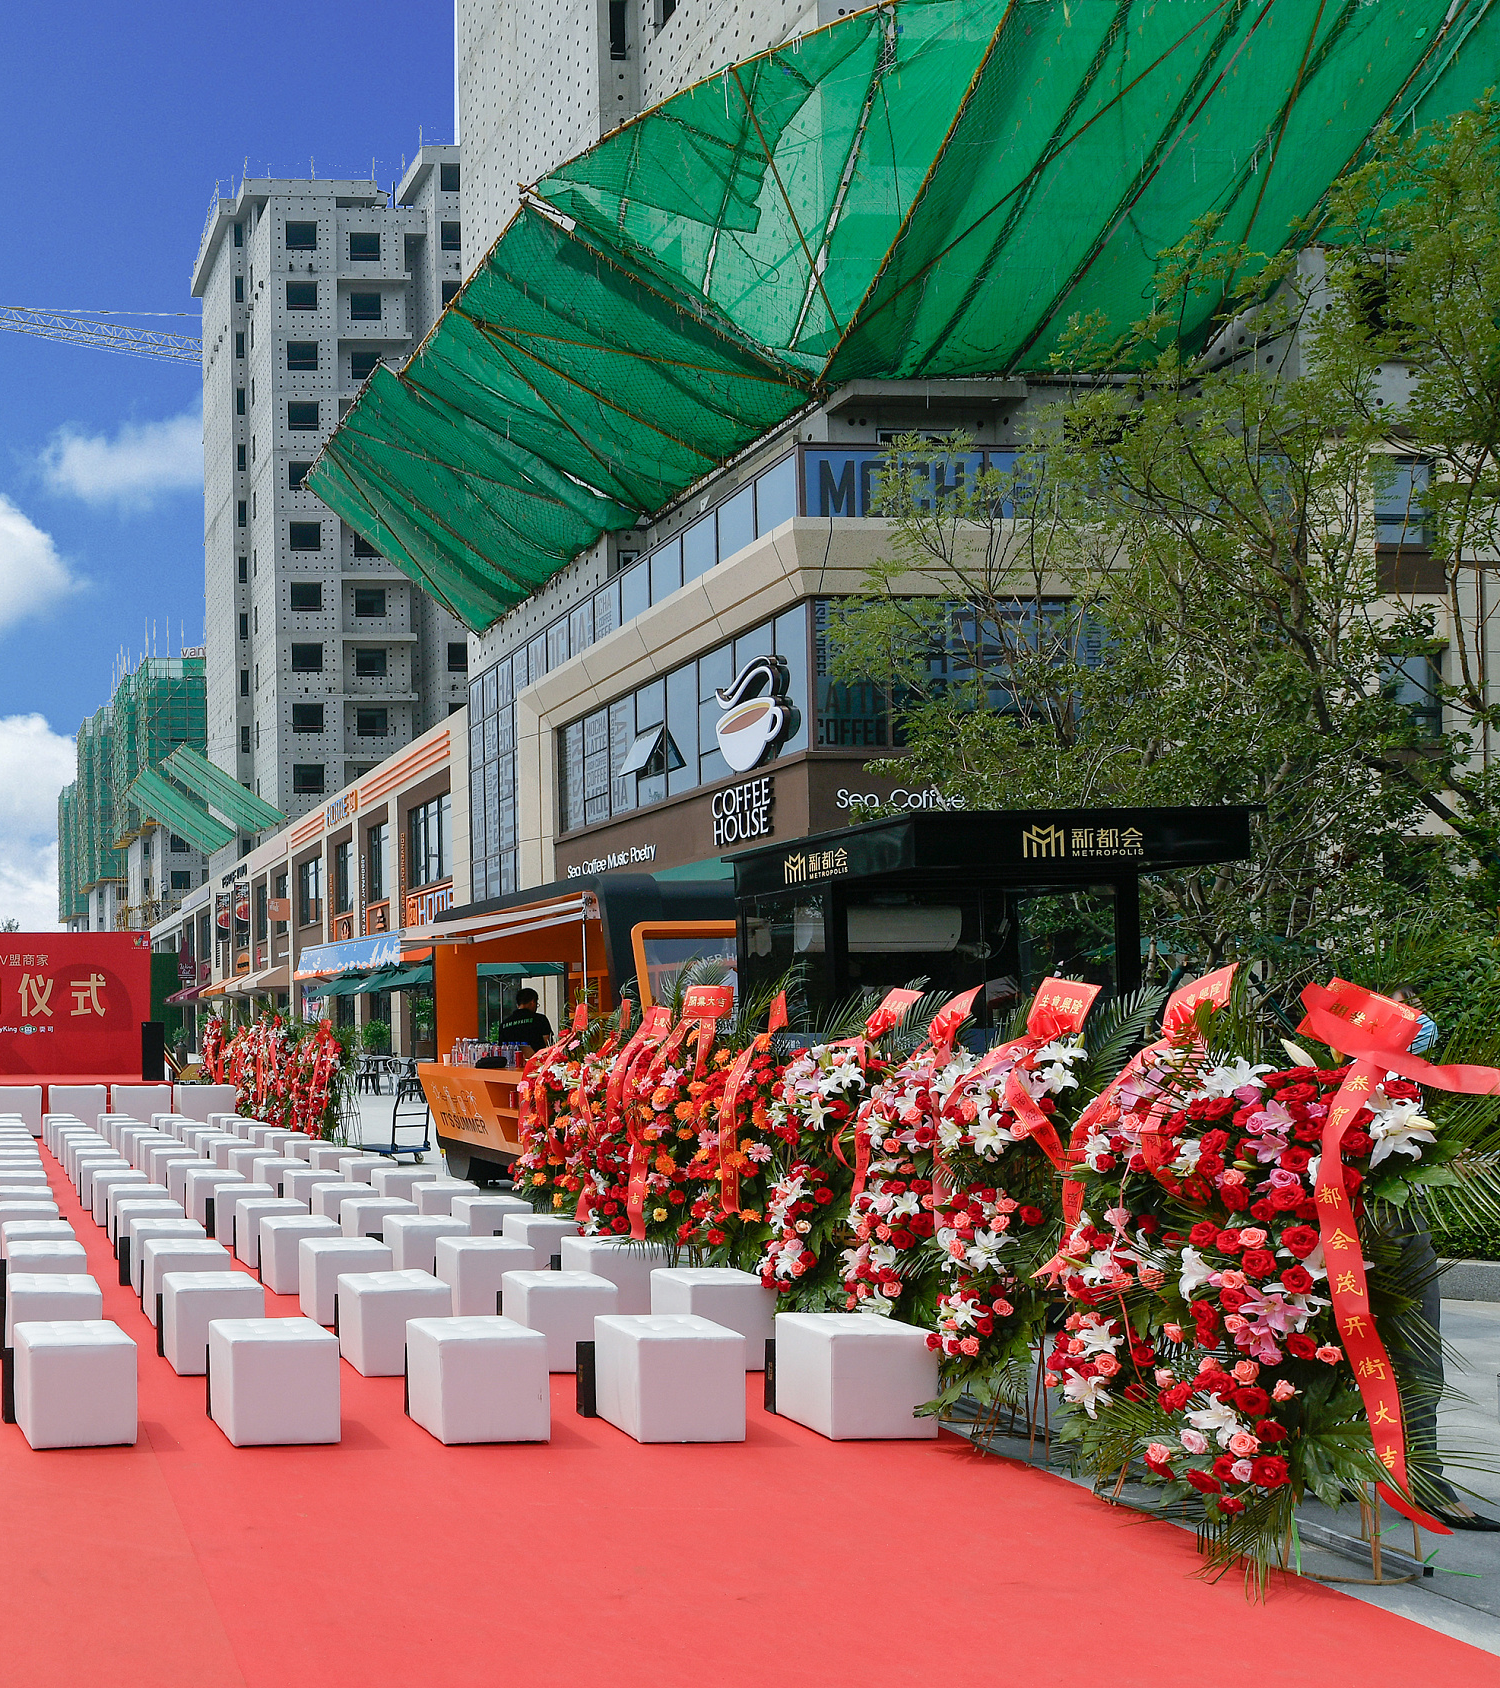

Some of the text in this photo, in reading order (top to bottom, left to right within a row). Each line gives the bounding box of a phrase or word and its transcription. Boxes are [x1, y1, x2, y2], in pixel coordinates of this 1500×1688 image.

[711, 777, 771, 819] COFFEE
[836, 788, 880, 810] Sea
[713, 806, 770, 847] HOUSE
[1071, 827, 1144, 849] 新都会
[567, 844, 657, 879] Sea Coffee Music Poetry
[808, 847, 848, 873] 新都会
[1071, 848, 1144, 857] METROPOLIS
[809, 866, 849, 880] METROPOLIS
[687, 995, 727, 1008] 開業大吉
[440, 1111, 489, 1136] IT'S SUMMER
